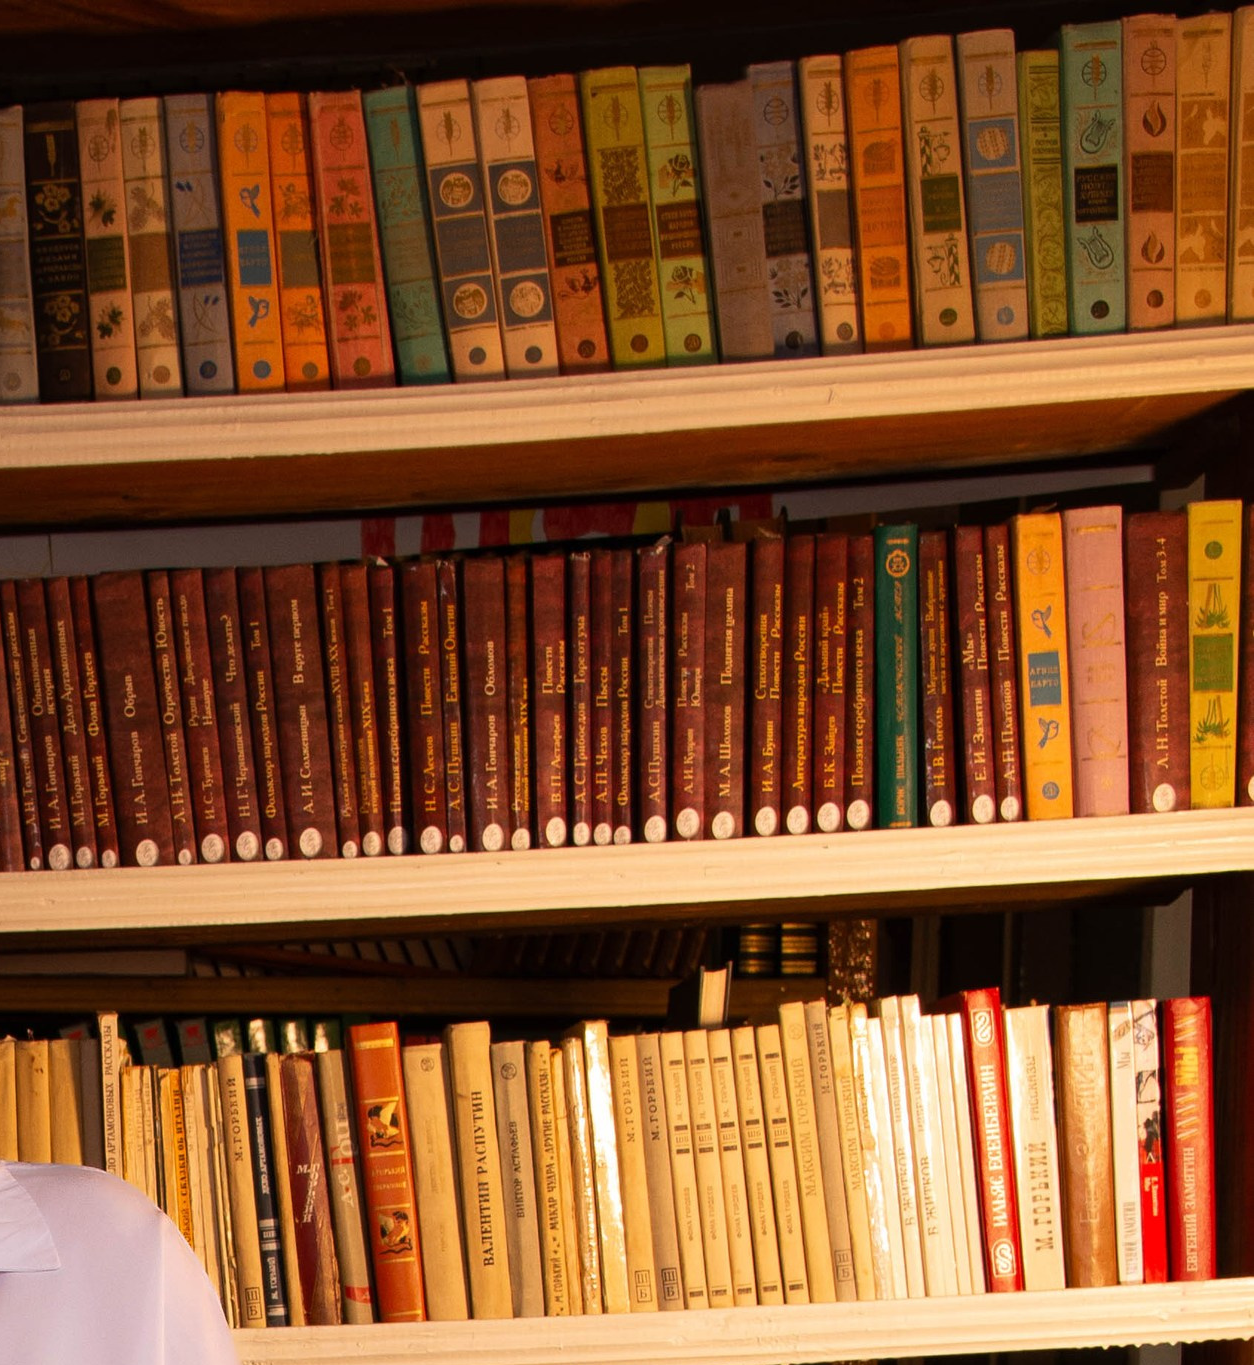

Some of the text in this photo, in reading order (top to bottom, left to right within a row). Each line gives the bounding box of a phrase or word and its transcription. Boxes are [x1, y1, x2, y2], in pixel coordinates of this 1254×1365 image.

[1156, 538, 1167, 559] 3-4
[1157, 561, 1168, 583] Том
[290, 599, 302, 639] первом
[723, 588, 734, 627] целина
[853, 588, 863, 609] Том
[1157, 592, 1169, 616] мир
[294, 642, 304, 671] круге
[485, 641, 495, 695] Обломов
[721, 630, 733, 684] Поднятая
[854, 630, 863, 657] века
[1155, 628, 1168, 667] Война
[83, 652, 95, 698] Гордеев
[853, 660, 865, 736] серебряного
[88, 701, 100, 736] Фома
[793, 616, 807, 791] Литература народов России
[1156, 679, 1168, 730] Толстой
[298, 705, 311, 778] Солженицын
[486, 715, 498, 772] Гончаров
[720, 706, 732, 759] Шолохов
[93, 756, 108, 805] Горький
[852, 739, 864, 785] Поэзия
[104, 1025, 113, 1075] РАССКАЗЫ
[105, 1083, 115, 1154] АРТАМОНОВЫХ
[619, 1058, 635, 1142] М.ГОРЬКИЙ
[643, 1056, 660, 1141] М.ГОРЬКИЙ
[791, 1057, 816, 1196] МАКСИМ ГОРЬКИЙ
[981, 1064, 1007, 1227] ИЛЬЯС ЕСЕНБЕРЛИН
[471, 1090, 495, 1266] ВАЛЕНТИН РАСПУТИН
[509, 1121, 525, 1218] ВИКТОР АСТАФЬЕВ
[1183, 1148, 1195, 1209] ЗАМЯТИН
[1184, 1214, 1198, 1272] ЕВГЕНИЙ
